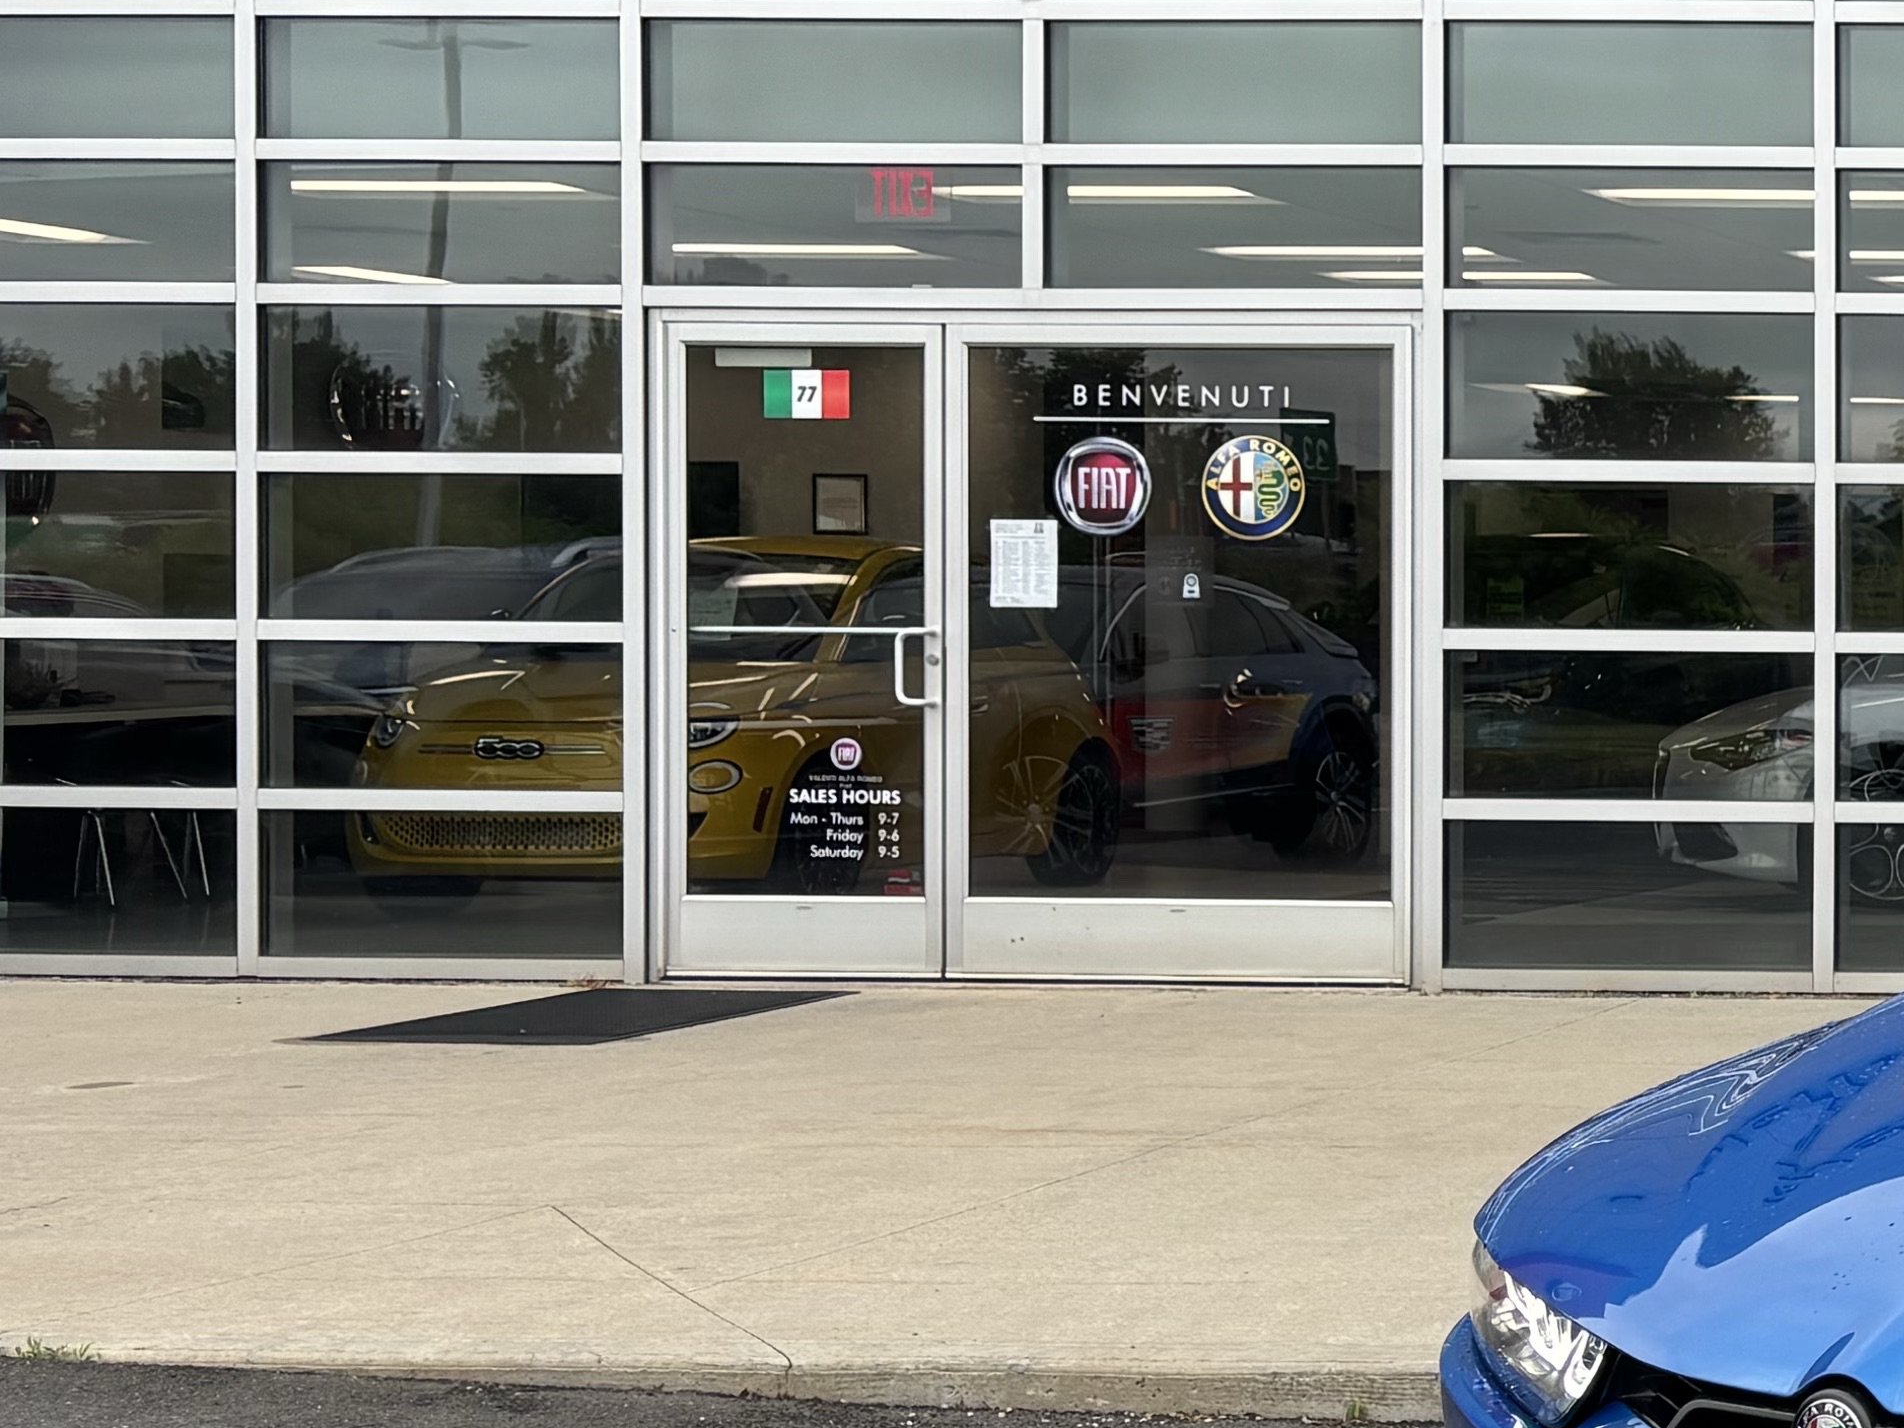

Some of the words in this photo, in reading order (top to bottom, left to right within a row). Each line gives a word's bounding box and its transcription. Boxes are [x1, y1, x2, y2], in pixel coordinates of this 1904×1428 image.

[797, 386, 817, 402] 77
[1072, 383, 1290, 408] BENVENUTI
[1206, 444, 1241, 491] ALFA
[1249, 438, 1301, 493] ROMEO
[1077, 466, 1131, 509] FIAT
[789, 788, 837, 804] SALES
[842, 789, 901, 805] HOURS
[790, 812, 818, 825] Mon
[830, 812, 864, 825] Thurs
[878, 812, 900, 825] 9-7
[826, 828, 864, 844] Friday
[878, 829, 900, 842] 9-6
[810, 844, 864, 861] Saturday
[878, 845, 900, 858] 9-5
